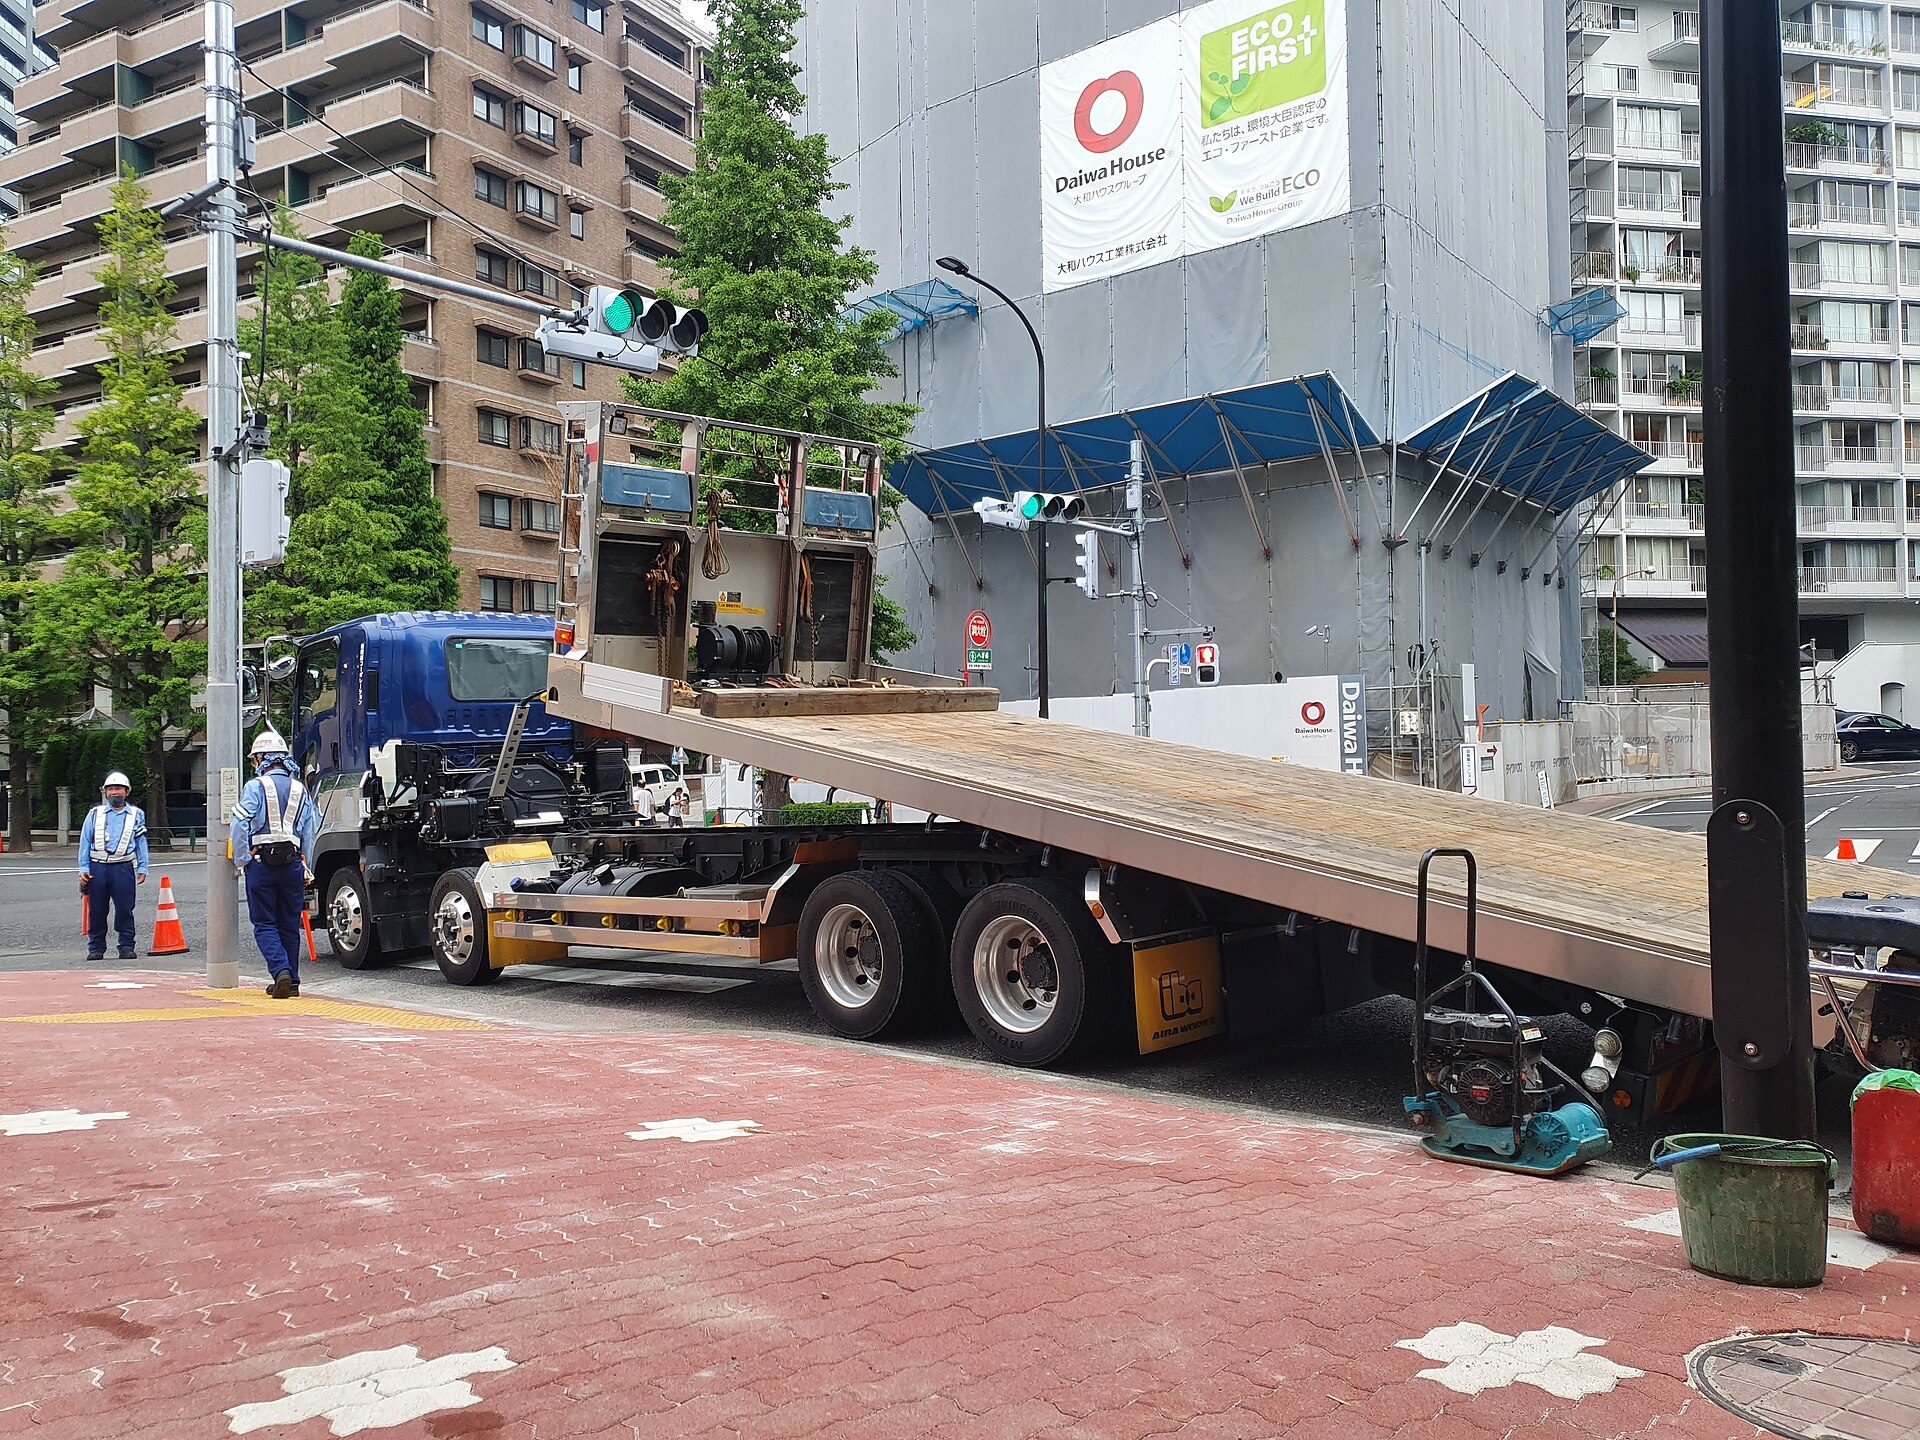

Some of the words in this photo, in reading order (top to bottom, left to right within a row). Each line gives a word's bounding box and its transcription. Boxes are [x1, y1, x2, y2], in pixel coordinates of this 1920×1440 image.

[1231, 12, 1294, 56] ECO
[1201, 97, 1327, 147] 私たちは、環境大臣認定の
[1202, 113, 1330, 162] エコ・ファースト企業です。
[1055, 169, 1107, 193] Daiwa
[1110, 147, 1166, 176] House
[1074, 173, 1148, 206] 大和ハウスグループ
[1239, 195, 1255, 206] We
[1255, 187, 1280, 202] Build
[1282, 168, 1320, 194] ECO
[1226, 213, 1252, 225] Daiwa
[1277, 199, 1304, 211] Group
[1057, 233, 1168, 275] 大和ハウス工業株式会社
[1341, 682, 1362, 754] Daiwa
